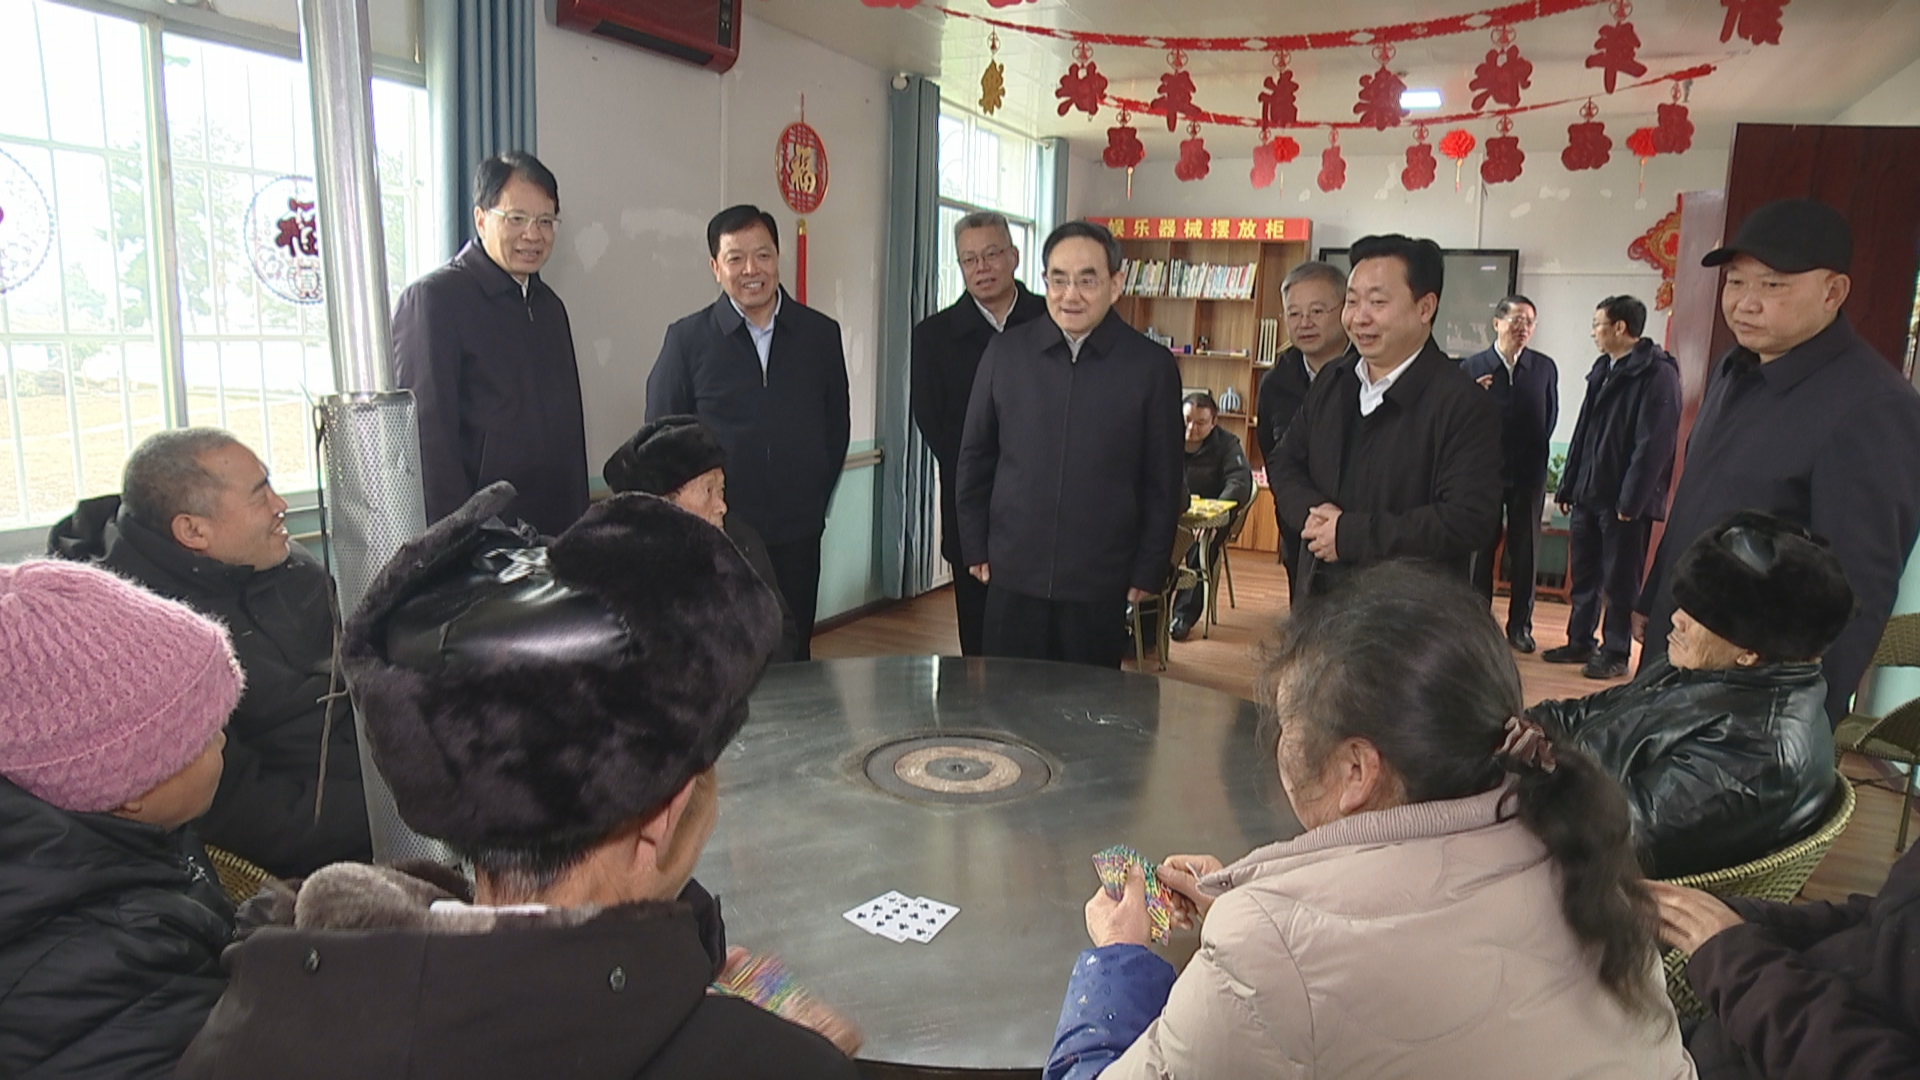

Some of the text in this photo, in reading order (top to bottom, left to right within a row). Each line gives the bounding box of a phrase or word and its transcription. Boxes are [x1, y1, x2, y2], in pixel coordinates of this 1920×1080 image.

[1107, 218, 1285, 239] 娱乐器械摆放柜
